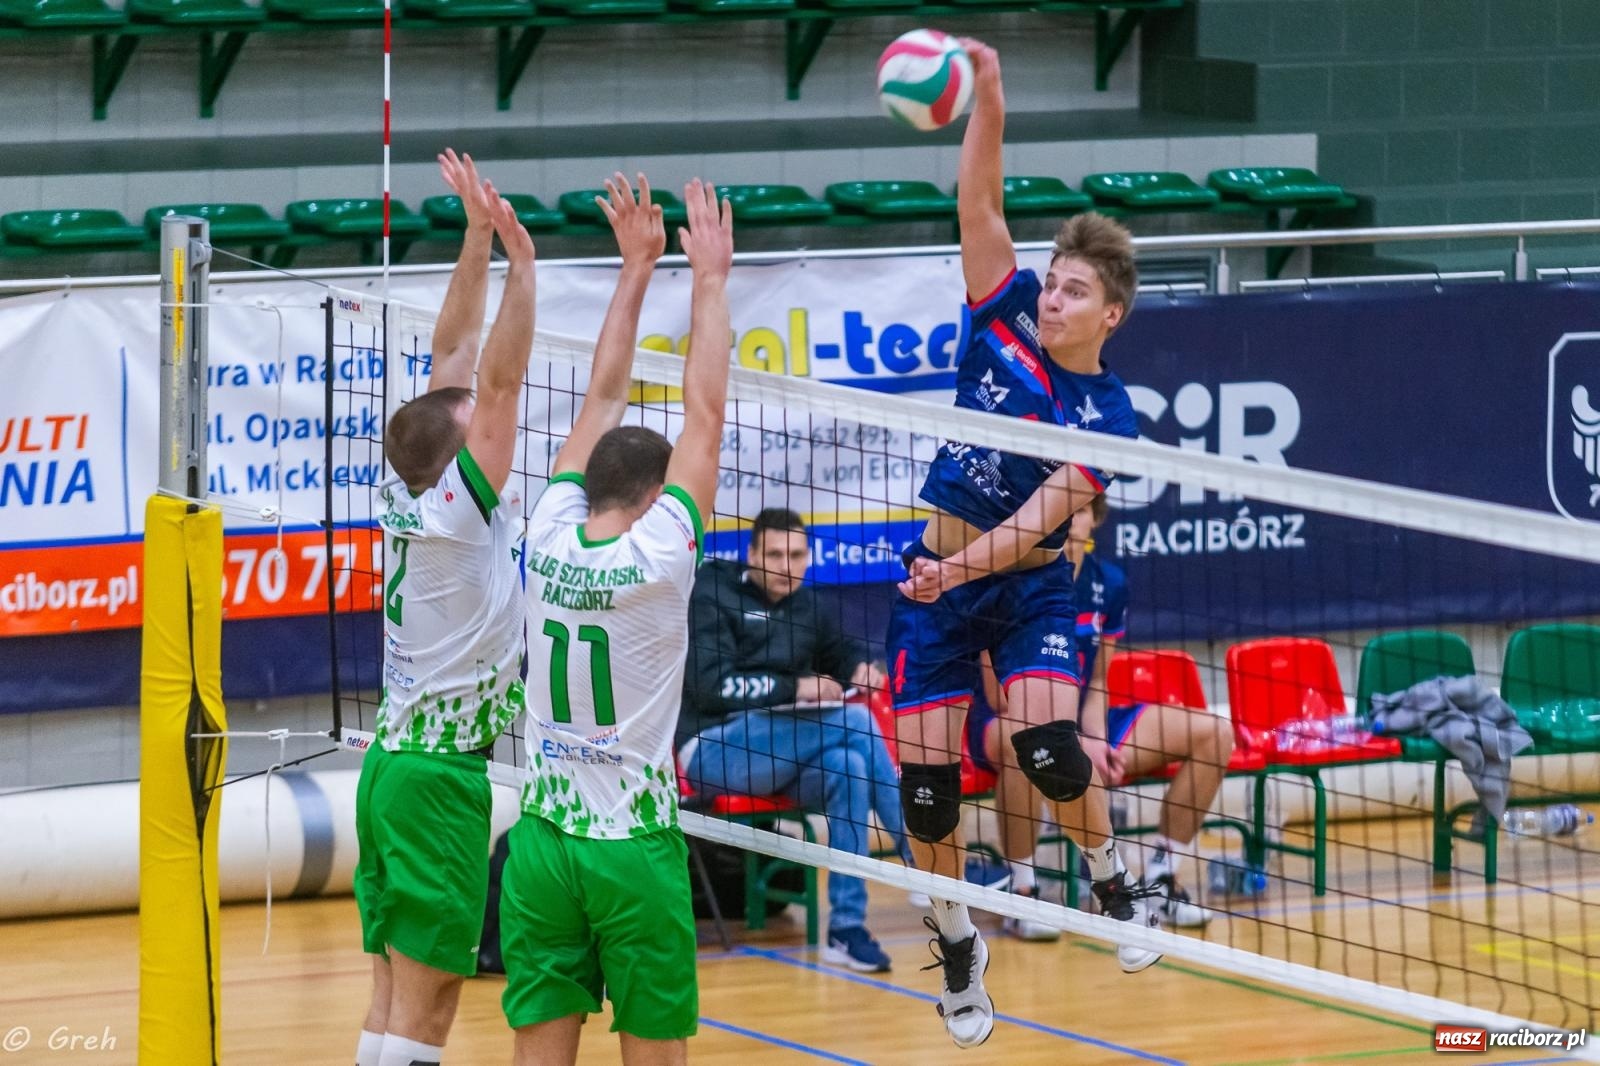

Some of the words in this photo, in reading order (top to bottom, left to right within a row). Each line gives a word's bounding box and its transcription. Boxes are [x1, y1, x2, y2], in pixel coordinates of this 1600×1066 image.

[339, 299, 361, 312] netex
[259, 361, 286, 385] w
[297, 349, 433, 384] Racibrz
[0, 413, 90, 455] ULTI
[246, 407, 379, 449] Opawsk
[0, 458, 96, 508] NIA
[248, 459, 379, 494] Mickew
[869, 455, 931, 482] Eiche
[1116, 506, 1306, 558] RACIBÓRZ
[0, 564, 138, 617] ciborz.pl
[222, 545, 290, 606] 70
[301, 542, 358, 602] 77
[386, 536, 410, 627] 2
[543, 618, 617, 726] 11
[347, 736, 370, 750] netex
